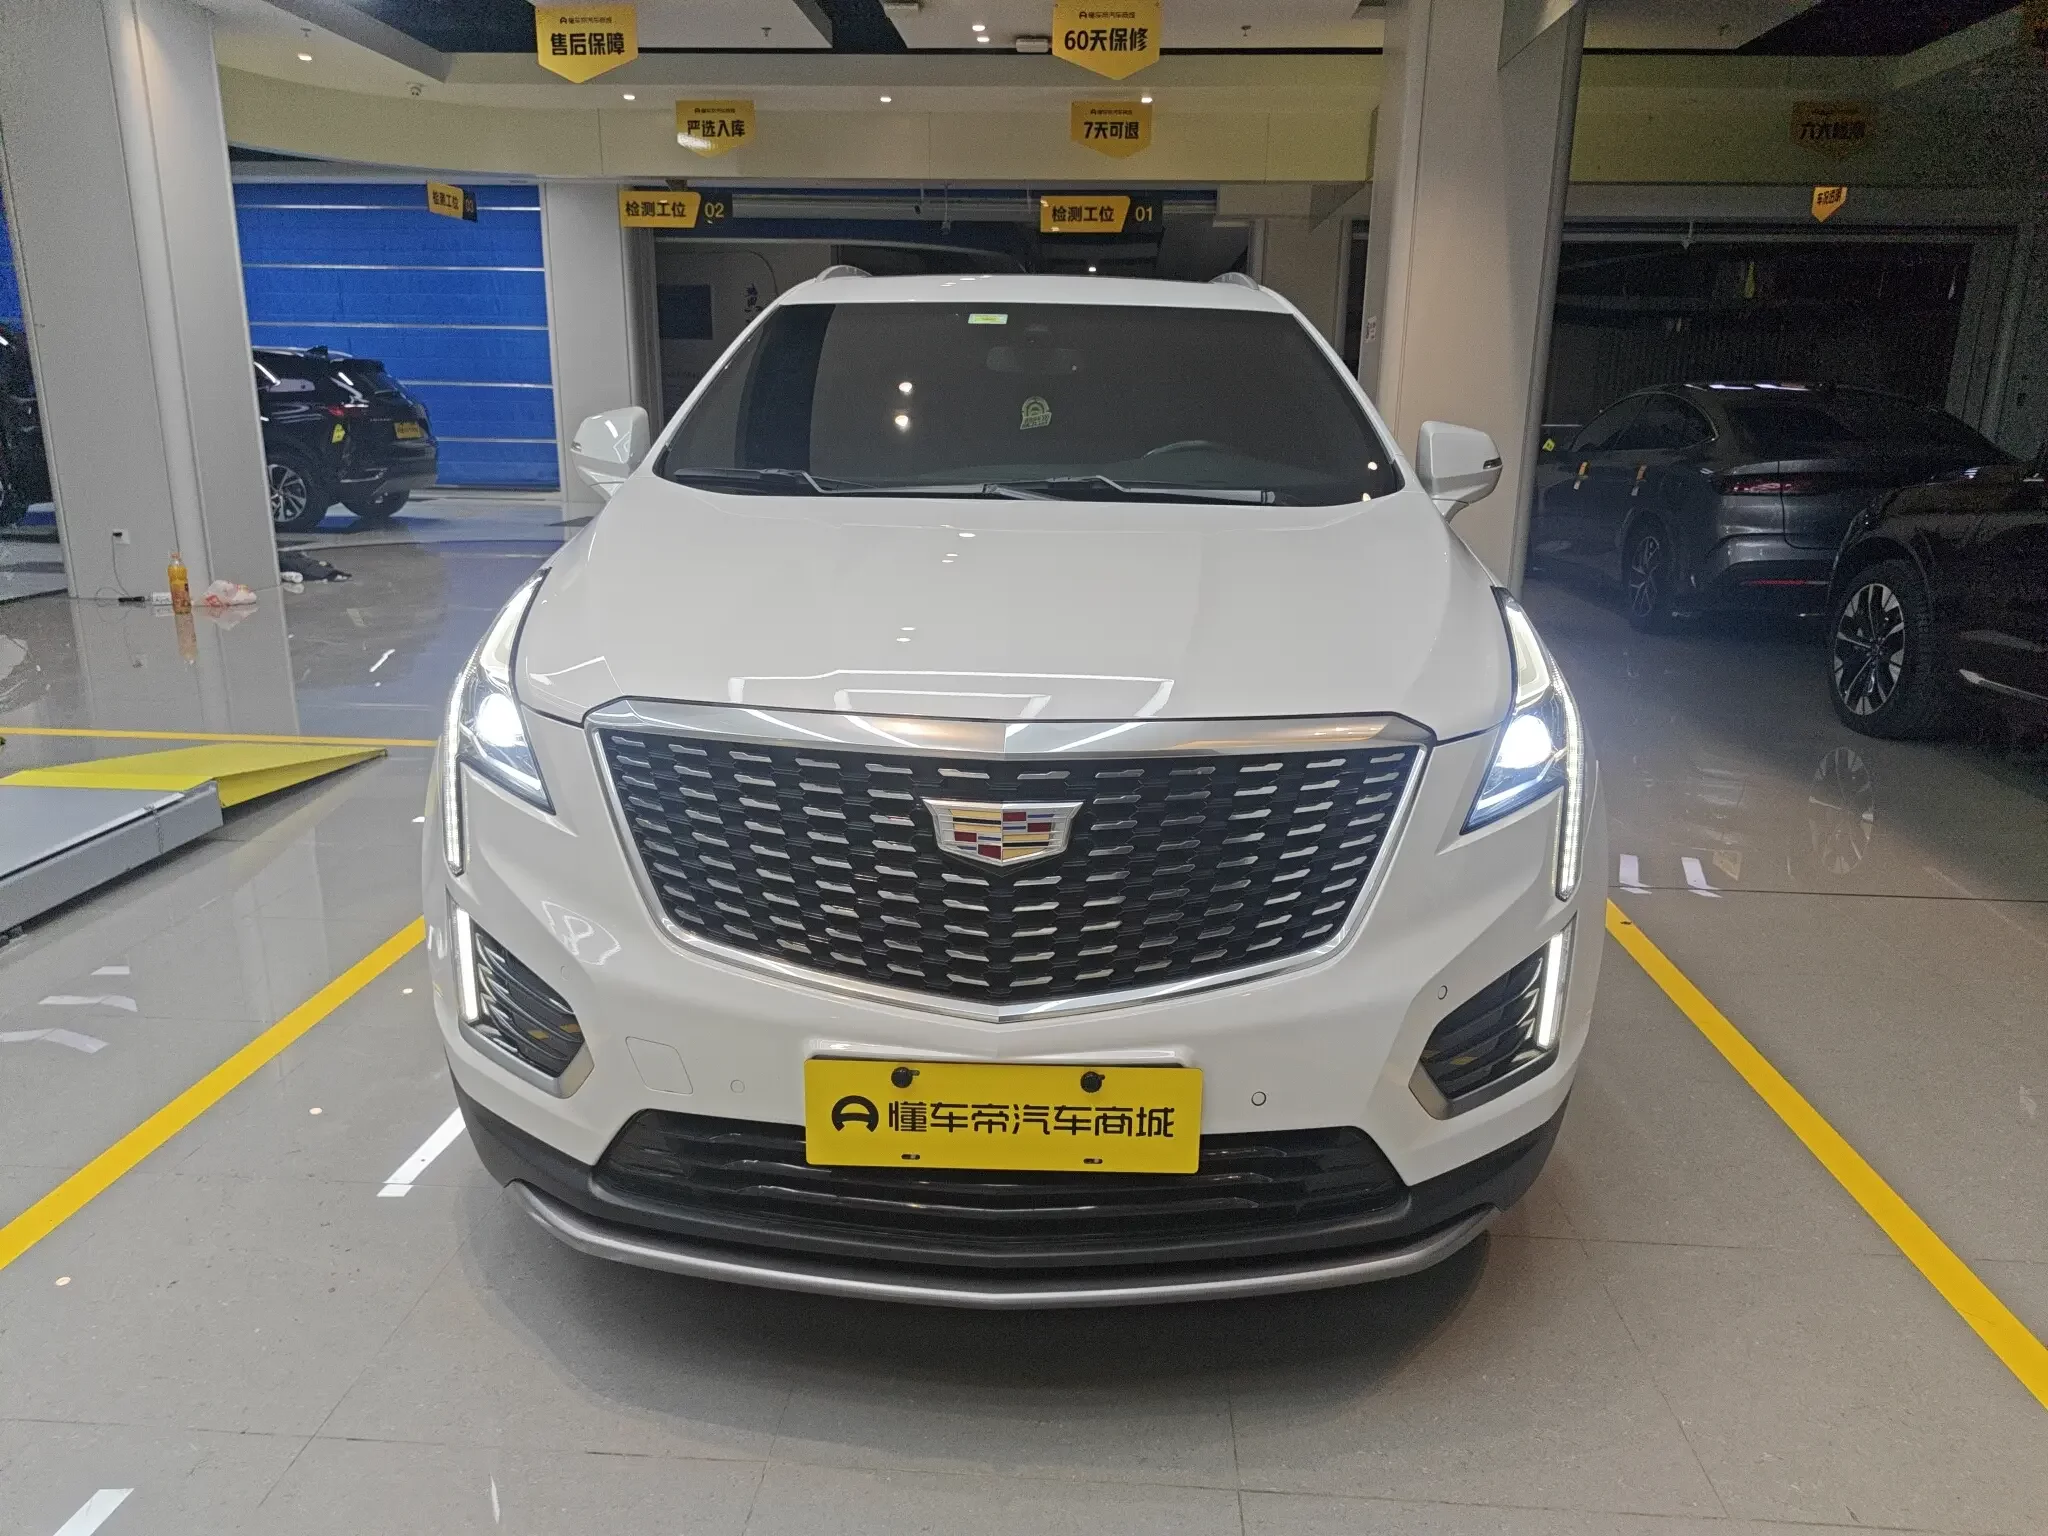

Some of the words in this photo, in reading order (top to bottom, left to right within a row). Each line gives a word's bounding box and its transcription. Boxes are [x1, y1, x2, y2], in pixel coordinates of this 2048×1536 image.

[551, 32, 625, 55] 售后保障
[1064, 28, 1148, 51] 60天保修
[687, 120, 746, 137] 严选入库
[1083, 121, 1140, 139] 7天可退
[625, 200, 687, 218] 检测工位
[704, 202, 725, 219] 02
[1051, 204, 1116, 223] 检测工位
[1135, 206, 1154, 222] 01
[887, 1101, 1175, 1138] 懂车帝汽车商城
